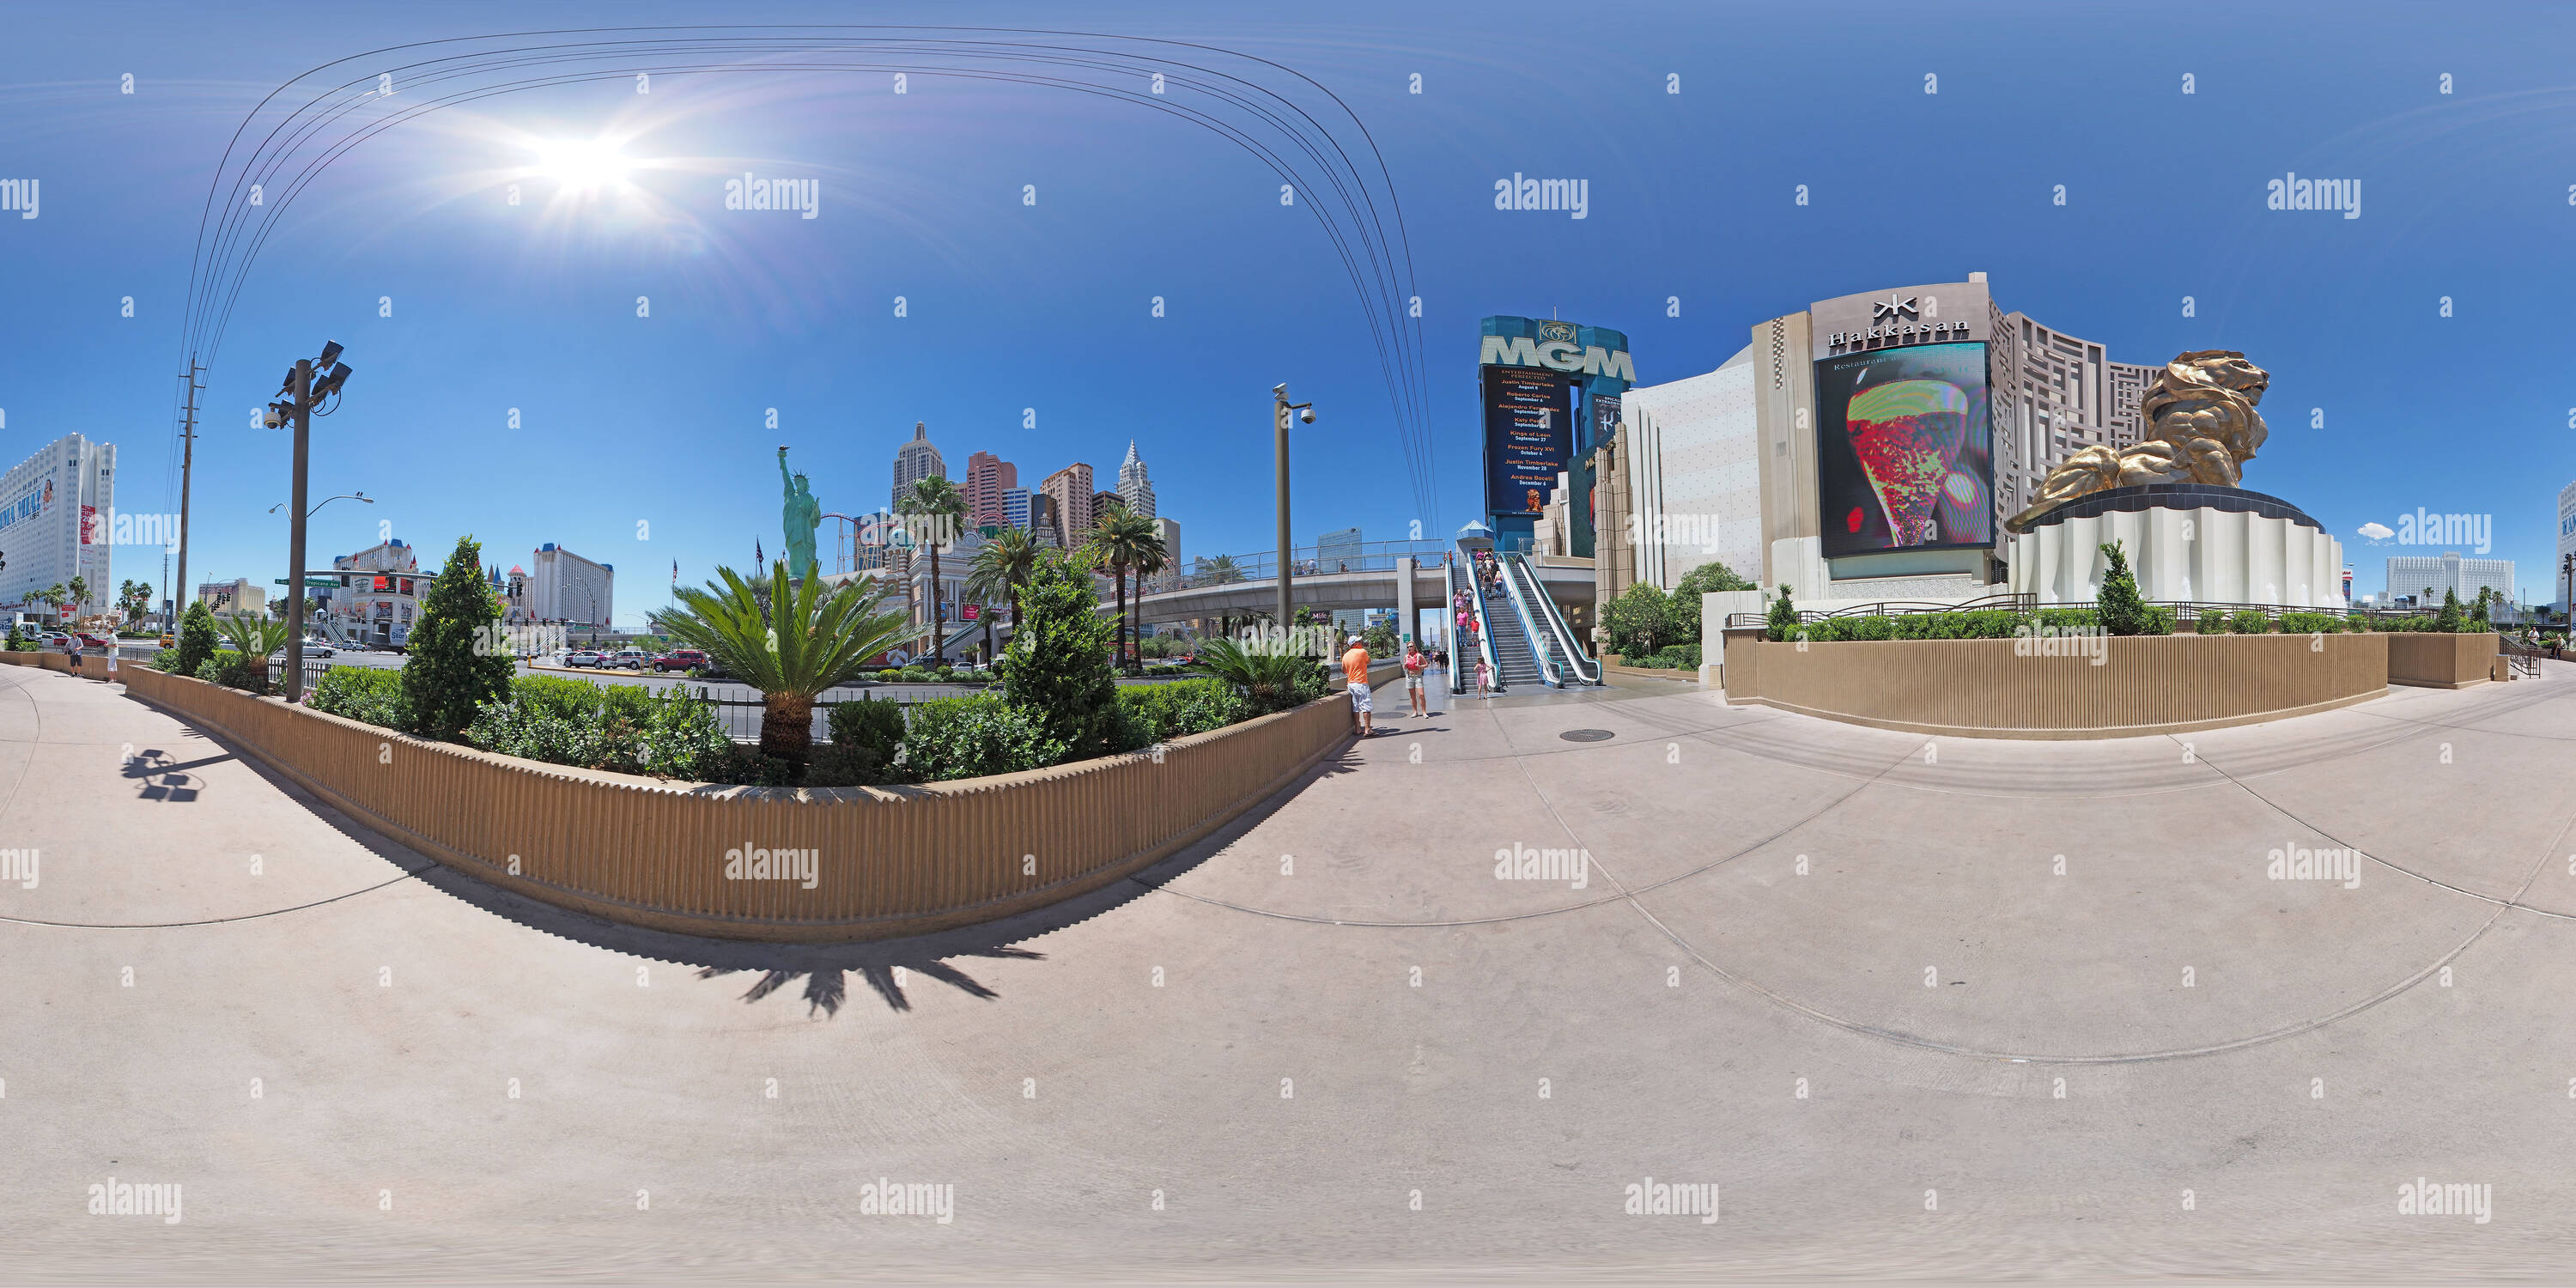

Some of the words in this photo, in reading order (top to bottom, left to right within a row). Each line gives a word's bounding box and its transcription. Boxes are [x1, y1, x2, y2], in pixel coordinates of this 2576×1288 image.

[1828, 320, 1970, 348] Hakkasan
[1480, 336, 1636, 382] MGM
[1834, 356, 1886, 371] Restaurant
[1501, 369, 1553, 378] ENTERTAINMENT
